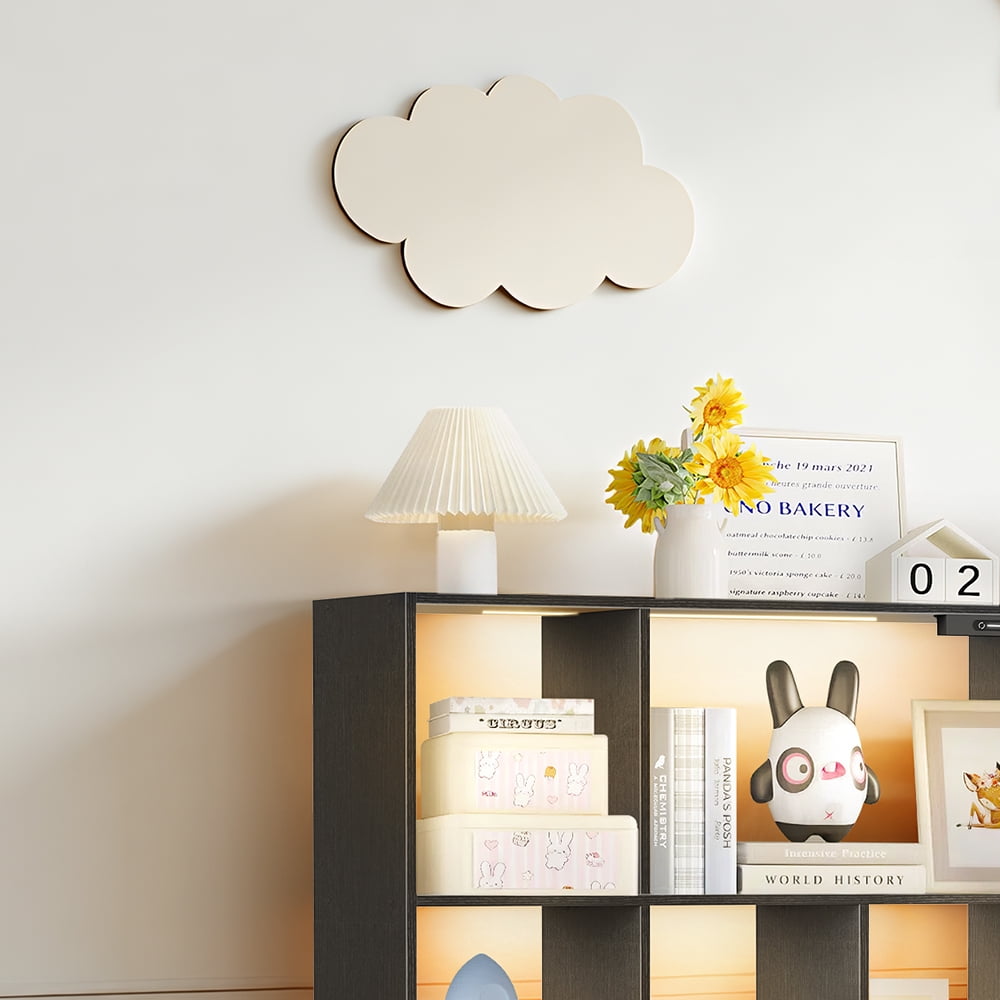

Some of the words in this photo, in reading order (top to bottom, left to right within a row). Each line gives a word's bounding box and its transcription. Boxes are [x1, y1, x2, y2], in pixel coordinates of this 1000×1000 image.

[802, 481, 833, 490] grande
[724, 500, 772, 515] NO
[779, 501, 865, 518] BAKERY
[727, 550, 769, 558] buttermilk
[754, 570, 784, 578] victoria
[786, 571, 813, 580] sponge
[729, 588, 766, 597] signature
[767, 590, 805, 598] raspberry
[807, 591, 839, 599] cupcake
[659, 774, 668, 849] CHEMISTRY
[722, 815, 731, 849] POSH
[765, 875, 823, 885] WORLD
[834, 875, 905, 886] HISTORY
